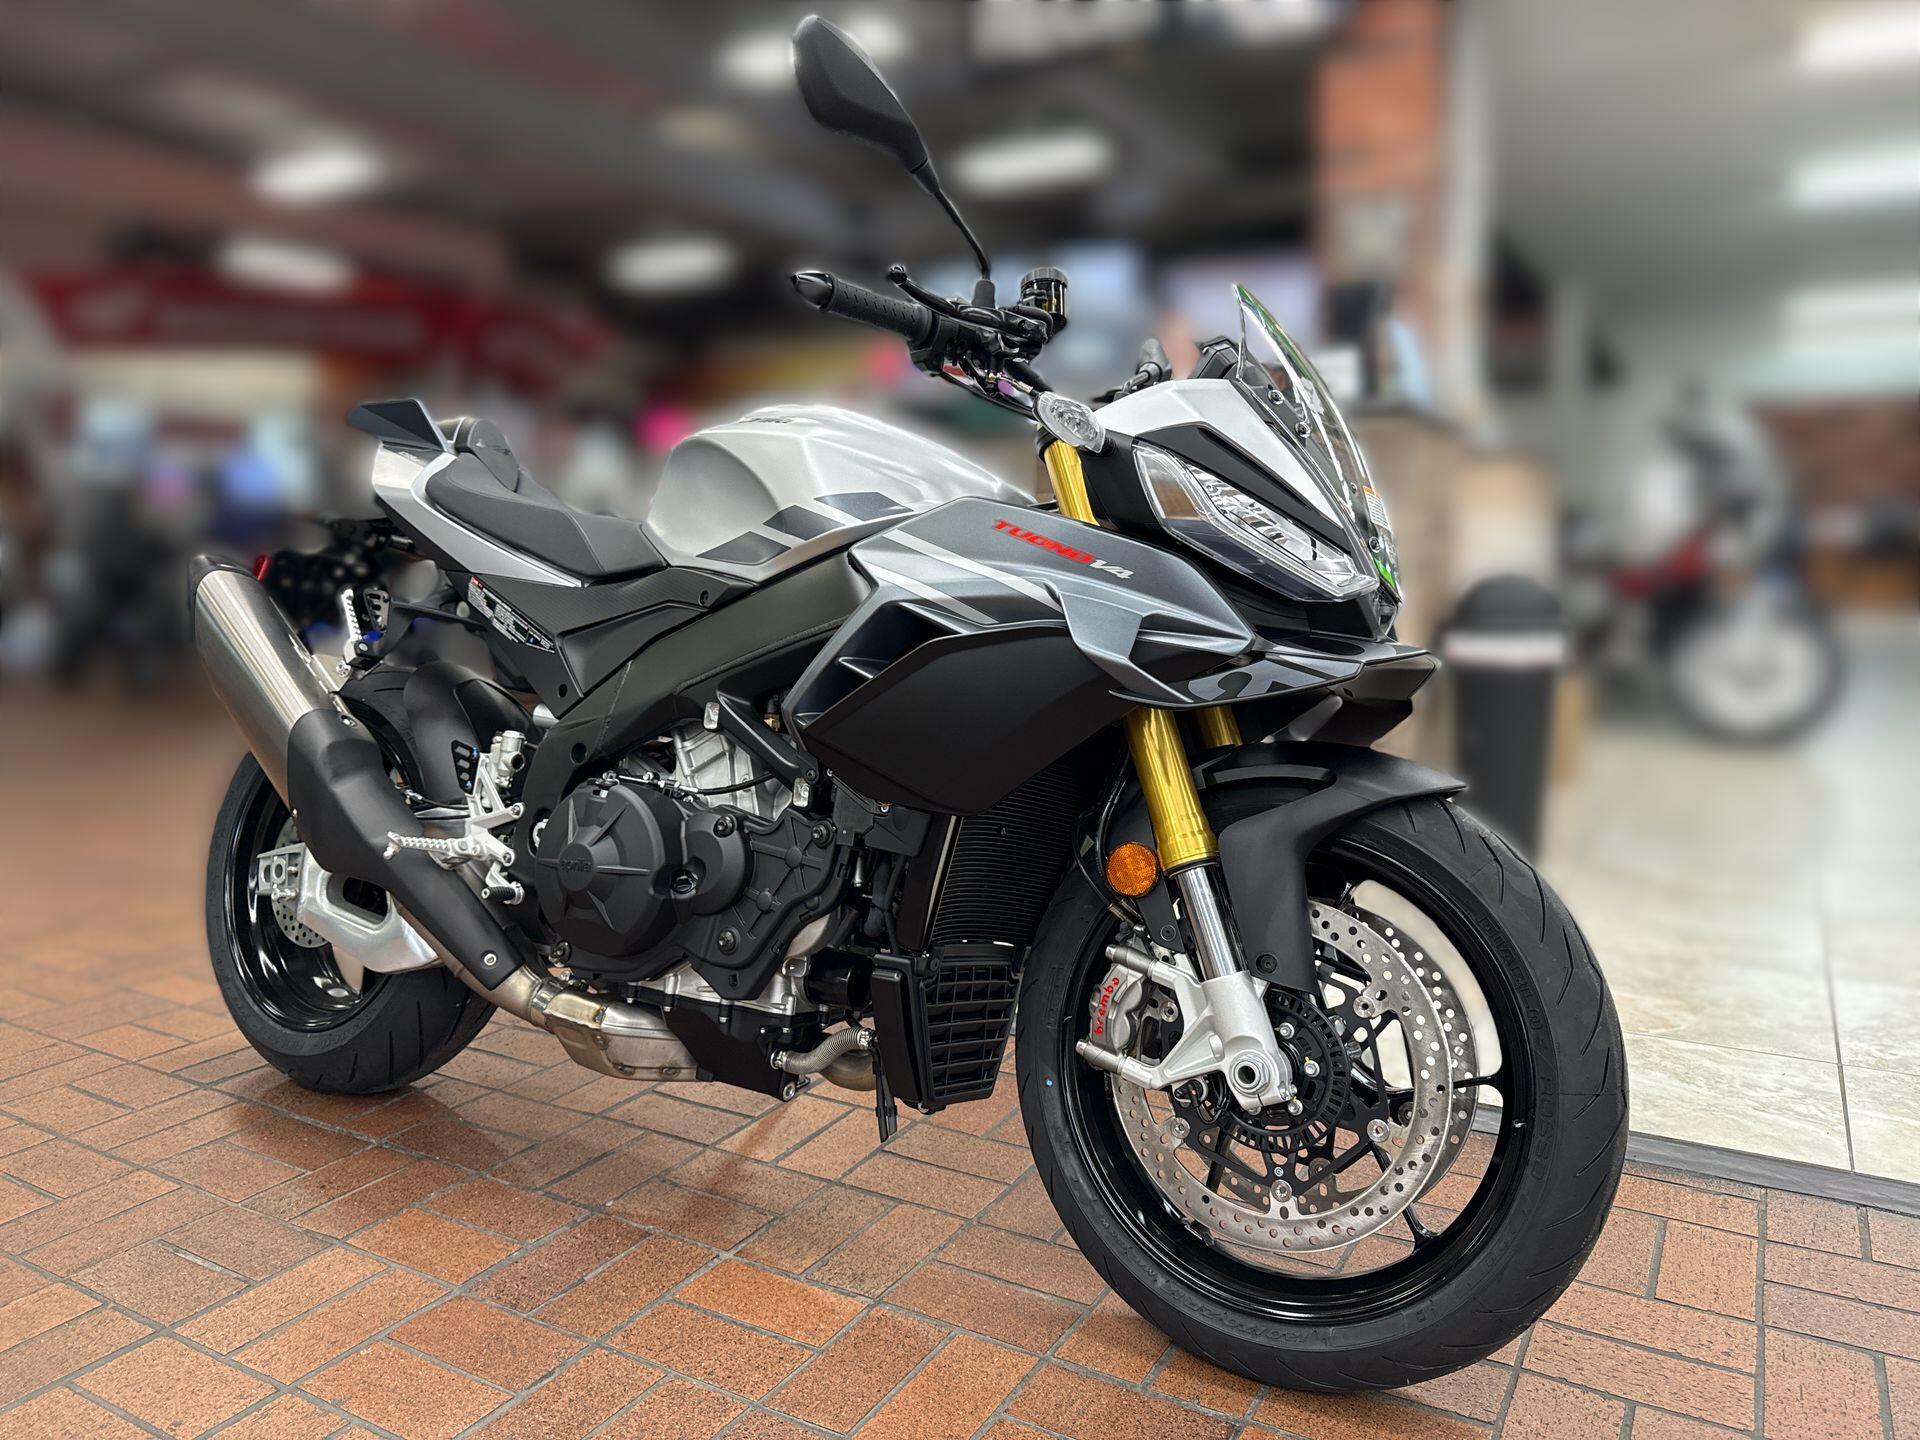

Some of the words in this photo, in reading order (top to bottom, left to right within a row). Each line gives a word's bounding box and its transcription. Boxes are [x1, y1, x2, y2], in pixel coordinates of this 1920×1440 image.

[993, 519, 1096, 564] TUONO
[1089, 560, 1135, 580] V4
[1092, 977, 1120, 1036] brembo
